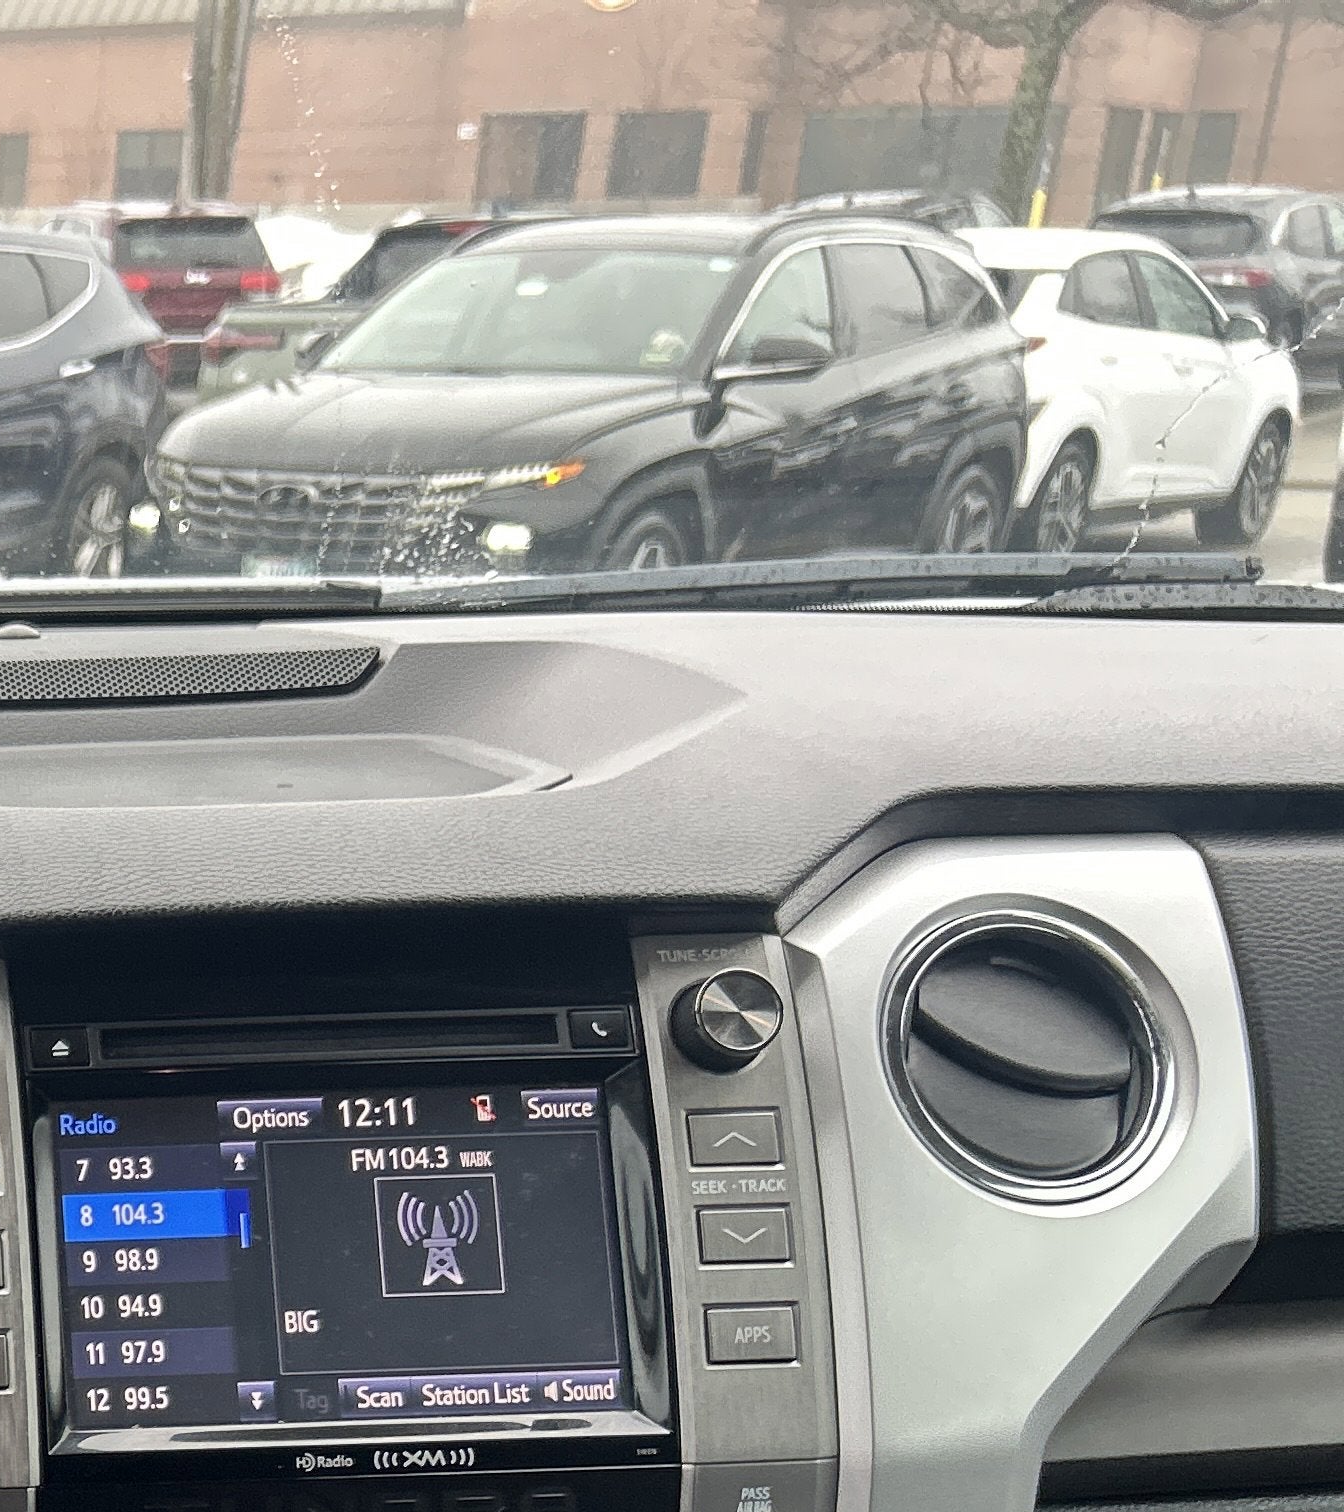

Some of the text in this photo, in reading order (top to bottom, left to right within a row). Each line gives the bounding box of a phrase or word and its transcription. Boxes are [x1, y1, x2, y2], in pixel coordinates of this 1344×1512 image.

[232, 1106, 310, 1131] Options
[337, 1099, 417, 1129] 12:11
[527, 1098, 594, 1120] Source
[58, 1112, 117, 1136] Radio
[75, 1156, 154, 1182] 7 93.3
[79, 1202, 165, 1227] 8 104.3
[82, 1249, 160, 1273] 9 98.9
[80, 1295, 162, 1319] 10 94.9
[284, 1309, 321, 1334] BIG
[734, 1325, 771, 1344] APPS
[85, 1341, 166, 1366] 11 97.9
[86, 1386, 169, 1412] 12 99.5
[356, 1385, 404, 1409] Scan
[421, 1381, 530, 1407] Station List
[561, 1378, 615, 1402] Sound
[741, 1486, 771, 1501] PASS
